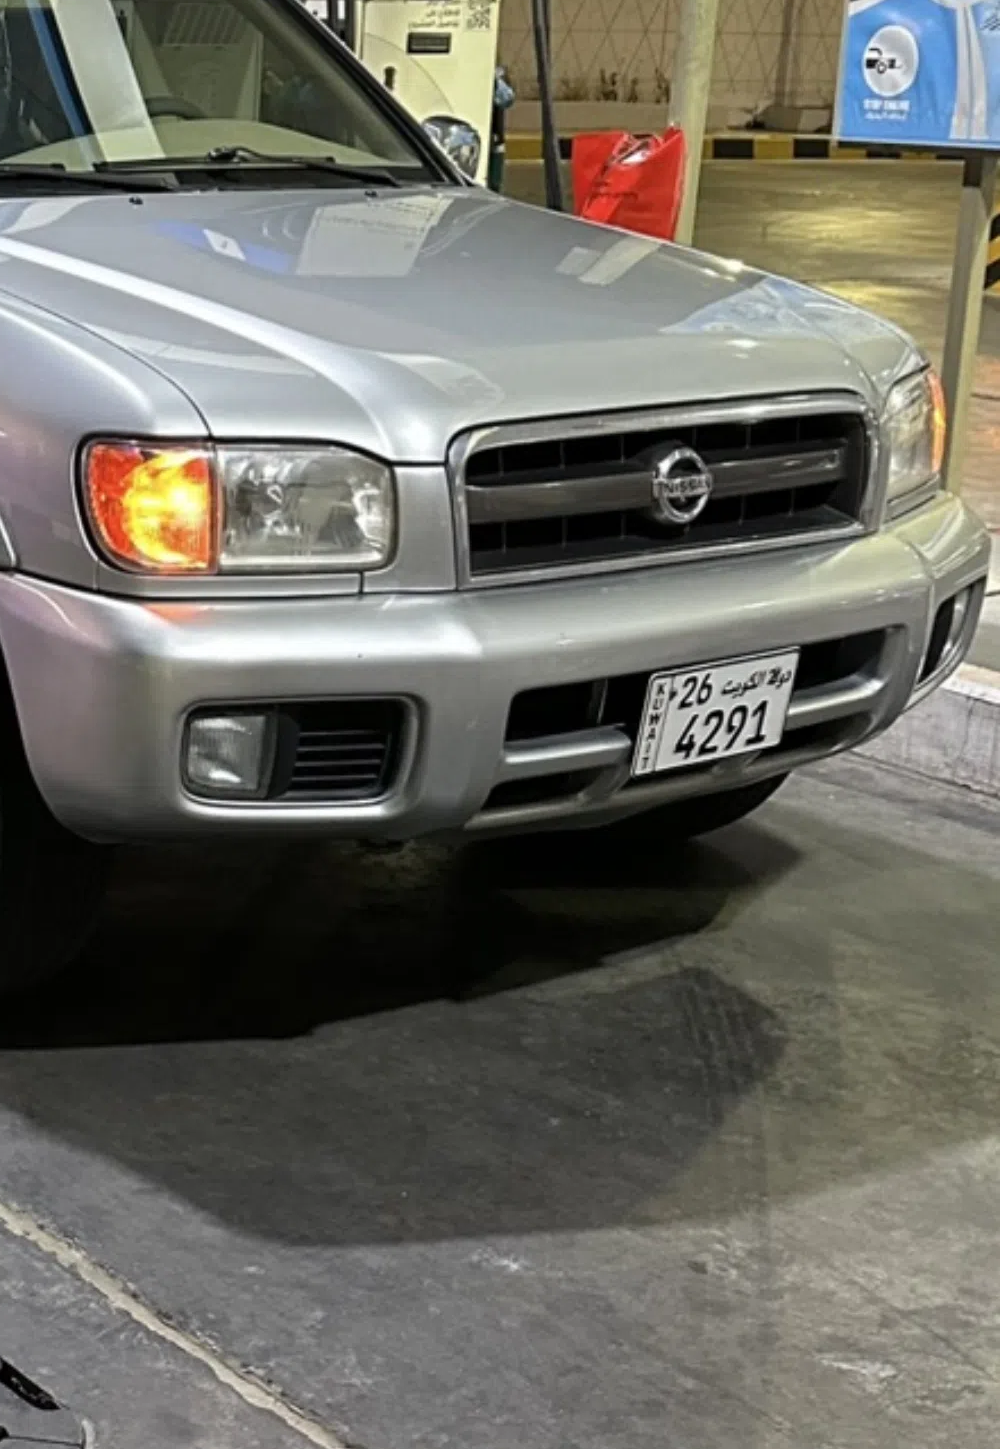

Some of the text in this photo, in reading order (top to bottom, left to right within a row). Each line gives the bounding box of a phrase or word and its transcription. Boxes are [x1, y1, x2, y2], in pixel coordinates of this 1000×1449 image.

[678, 674, 713, 710] 26
[720, 666, 792, 699] دولة الكويت
[641, 682, 667, 770] KUWAIT
[673, 700, 768, 760] 4291
